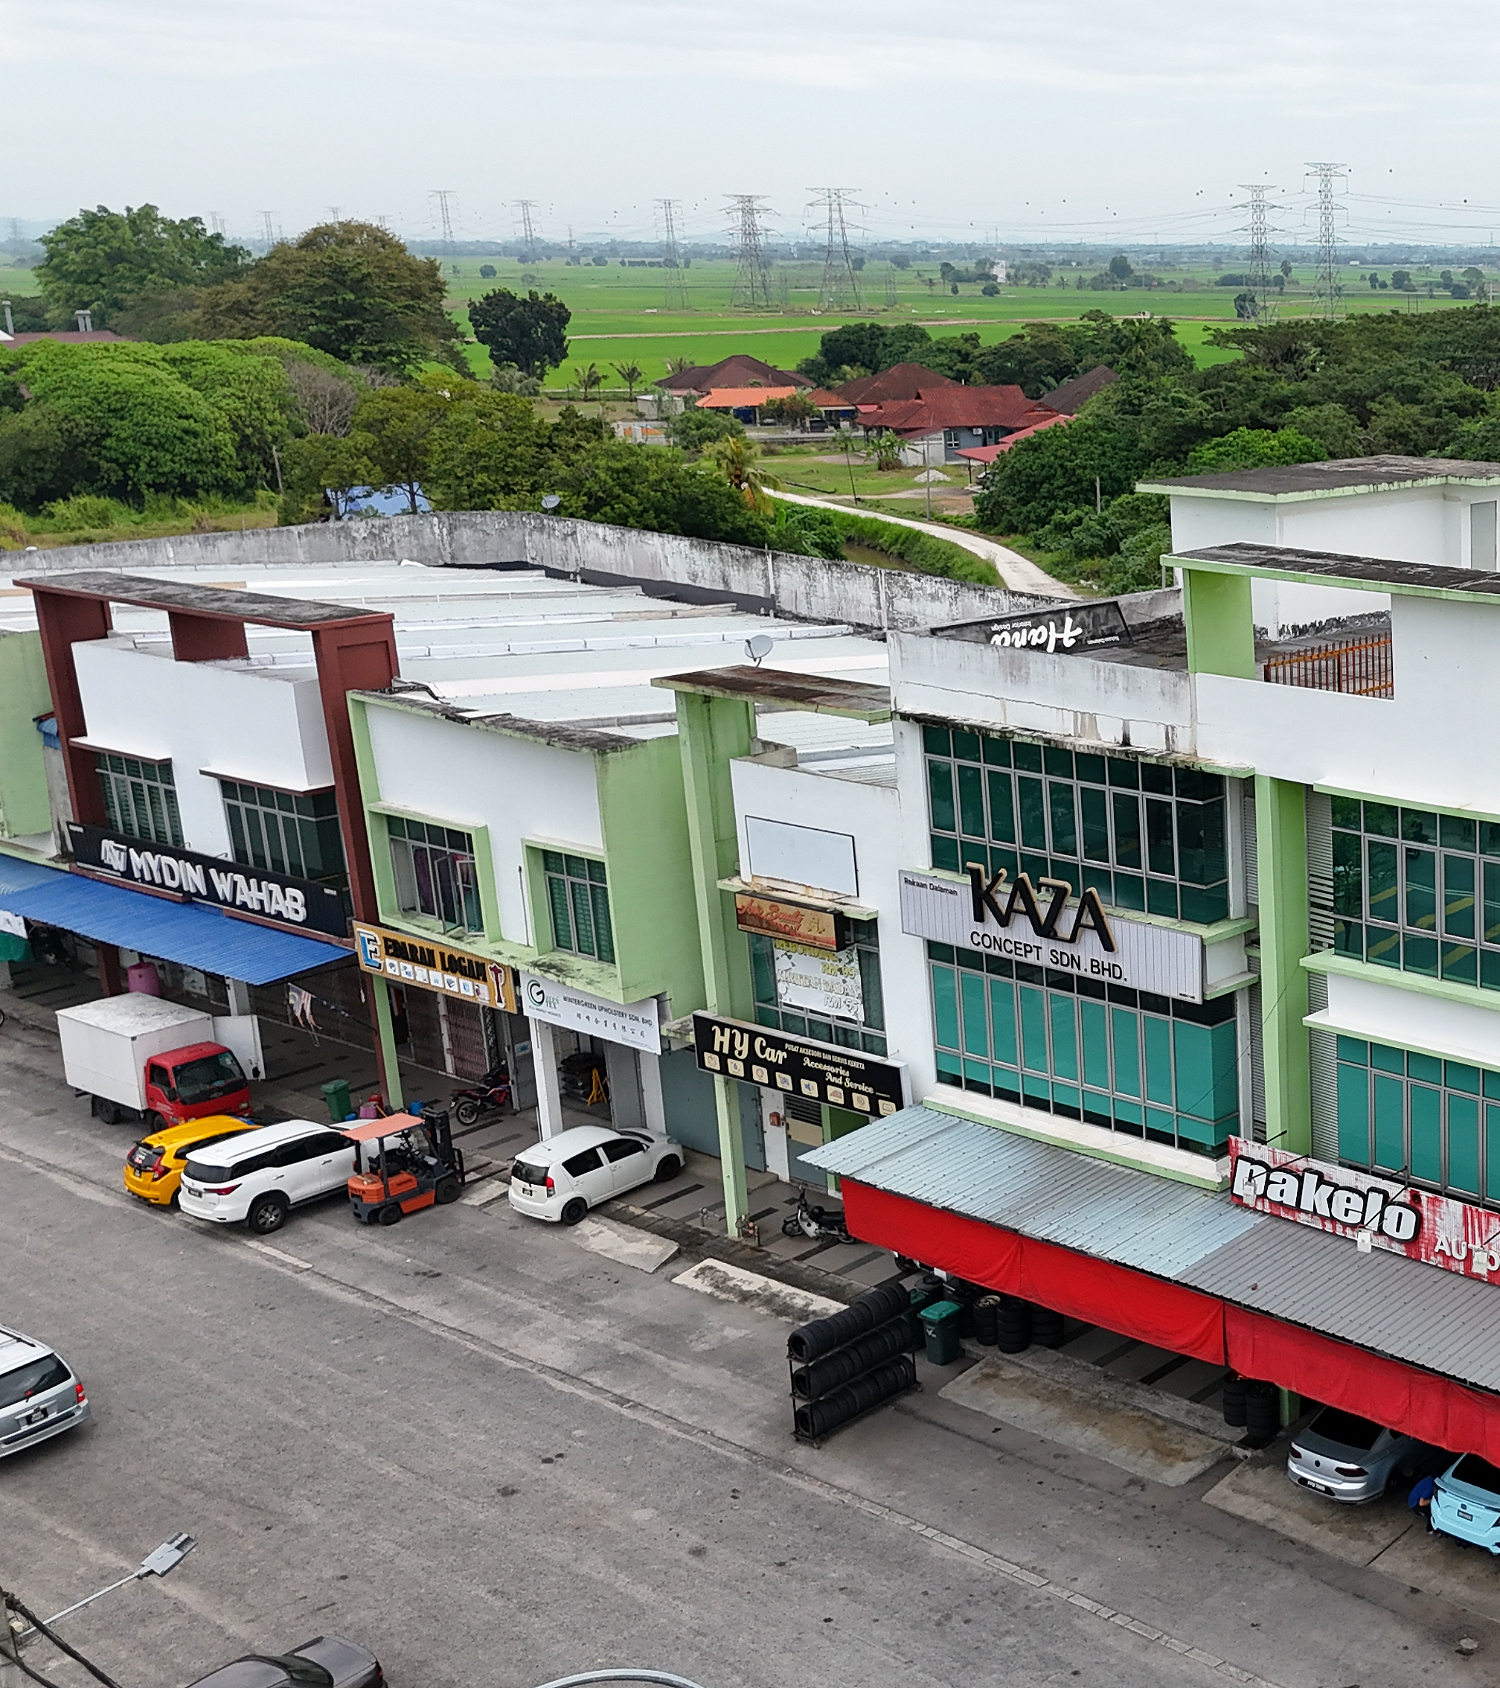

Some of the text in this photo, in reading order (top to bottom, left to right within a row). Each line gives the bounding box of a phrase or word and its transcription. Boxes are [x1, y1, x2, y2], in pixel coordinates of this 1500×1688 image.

[990, 617, 1083, 653] Hana
[129, 848, 307, 922] MYDIN WAHAB
[904, 877, 958, 897] Rekaan Dalaman
[965, 861, 1119, 953] KAZA
[439, 951, 488, 983] LOGAM
[970, 930, 1042, 961] CONCEPT
[1090, 957, 1127, 981] BHD.
[712, 1025, 788, 1065] HY Car
[802, 1056, 850, 1077] Accessories
[825, 1071, 874, 1095] And Service
[1232, 1157, 1418, 1242] pakelo
